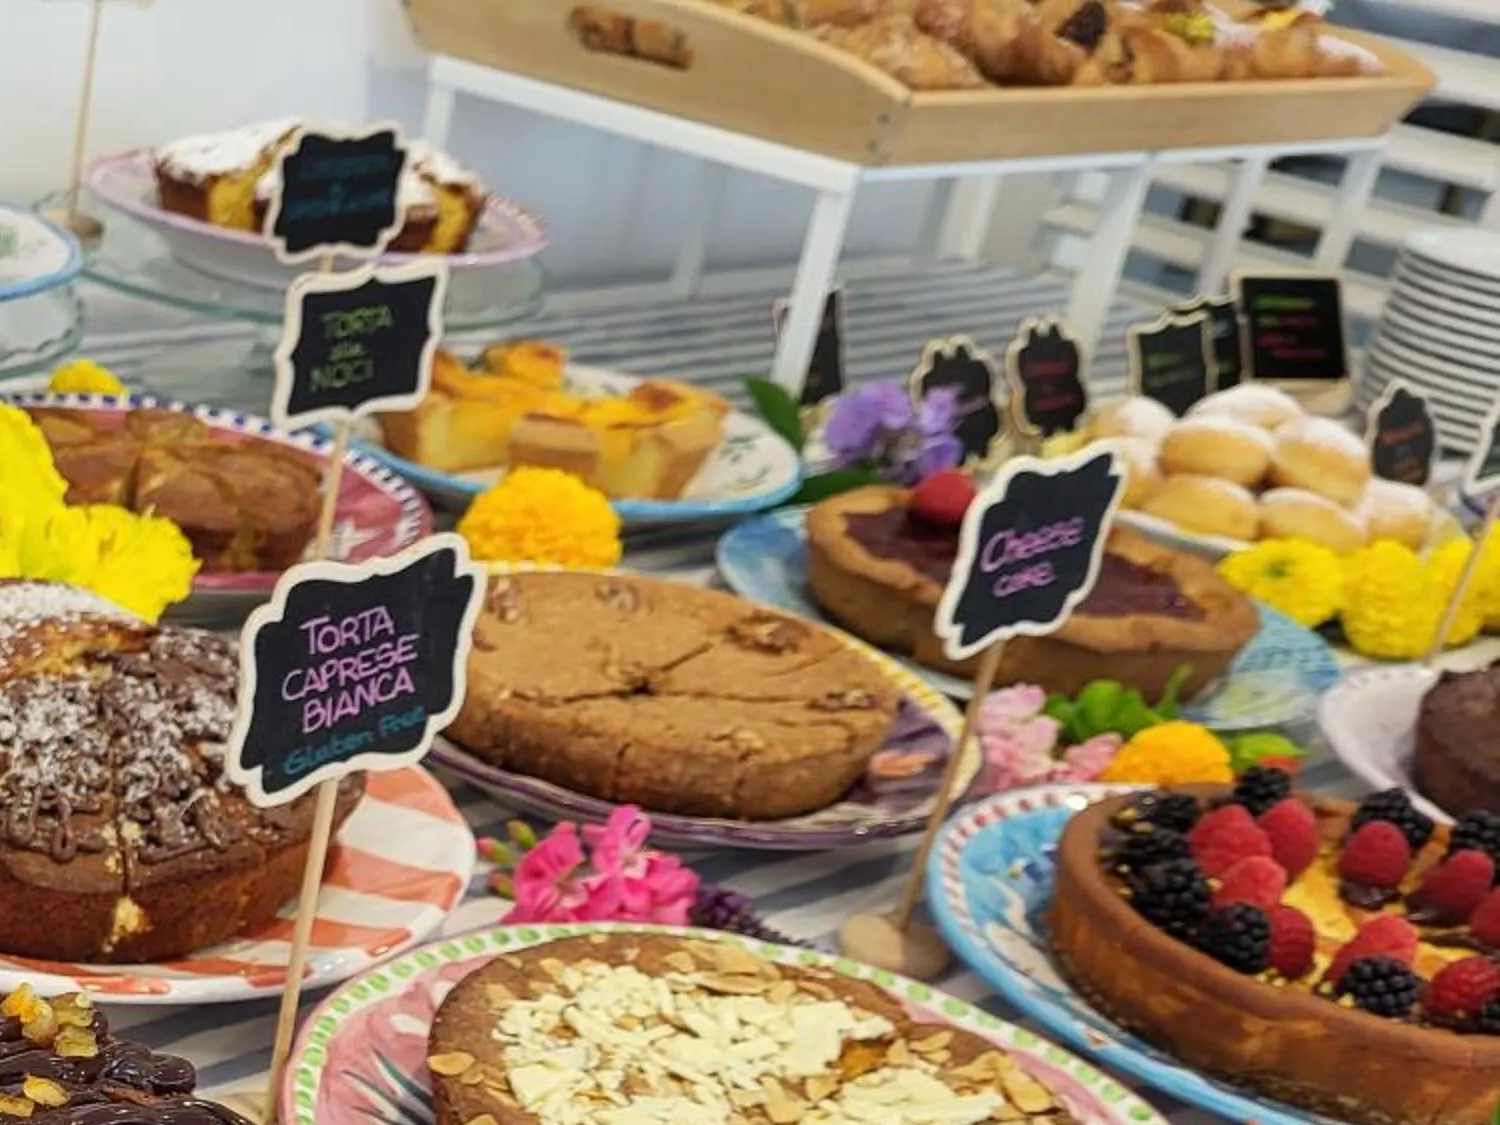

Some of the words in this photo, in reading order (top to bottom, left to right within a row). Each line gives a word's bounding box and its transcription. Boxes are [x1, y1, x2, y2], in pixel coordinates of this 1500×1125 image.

[299, 605, 396, 655] TORTA
[281, 634, 420, 701] CAPRESE
[302, 667, 415, 733] BIANCA
